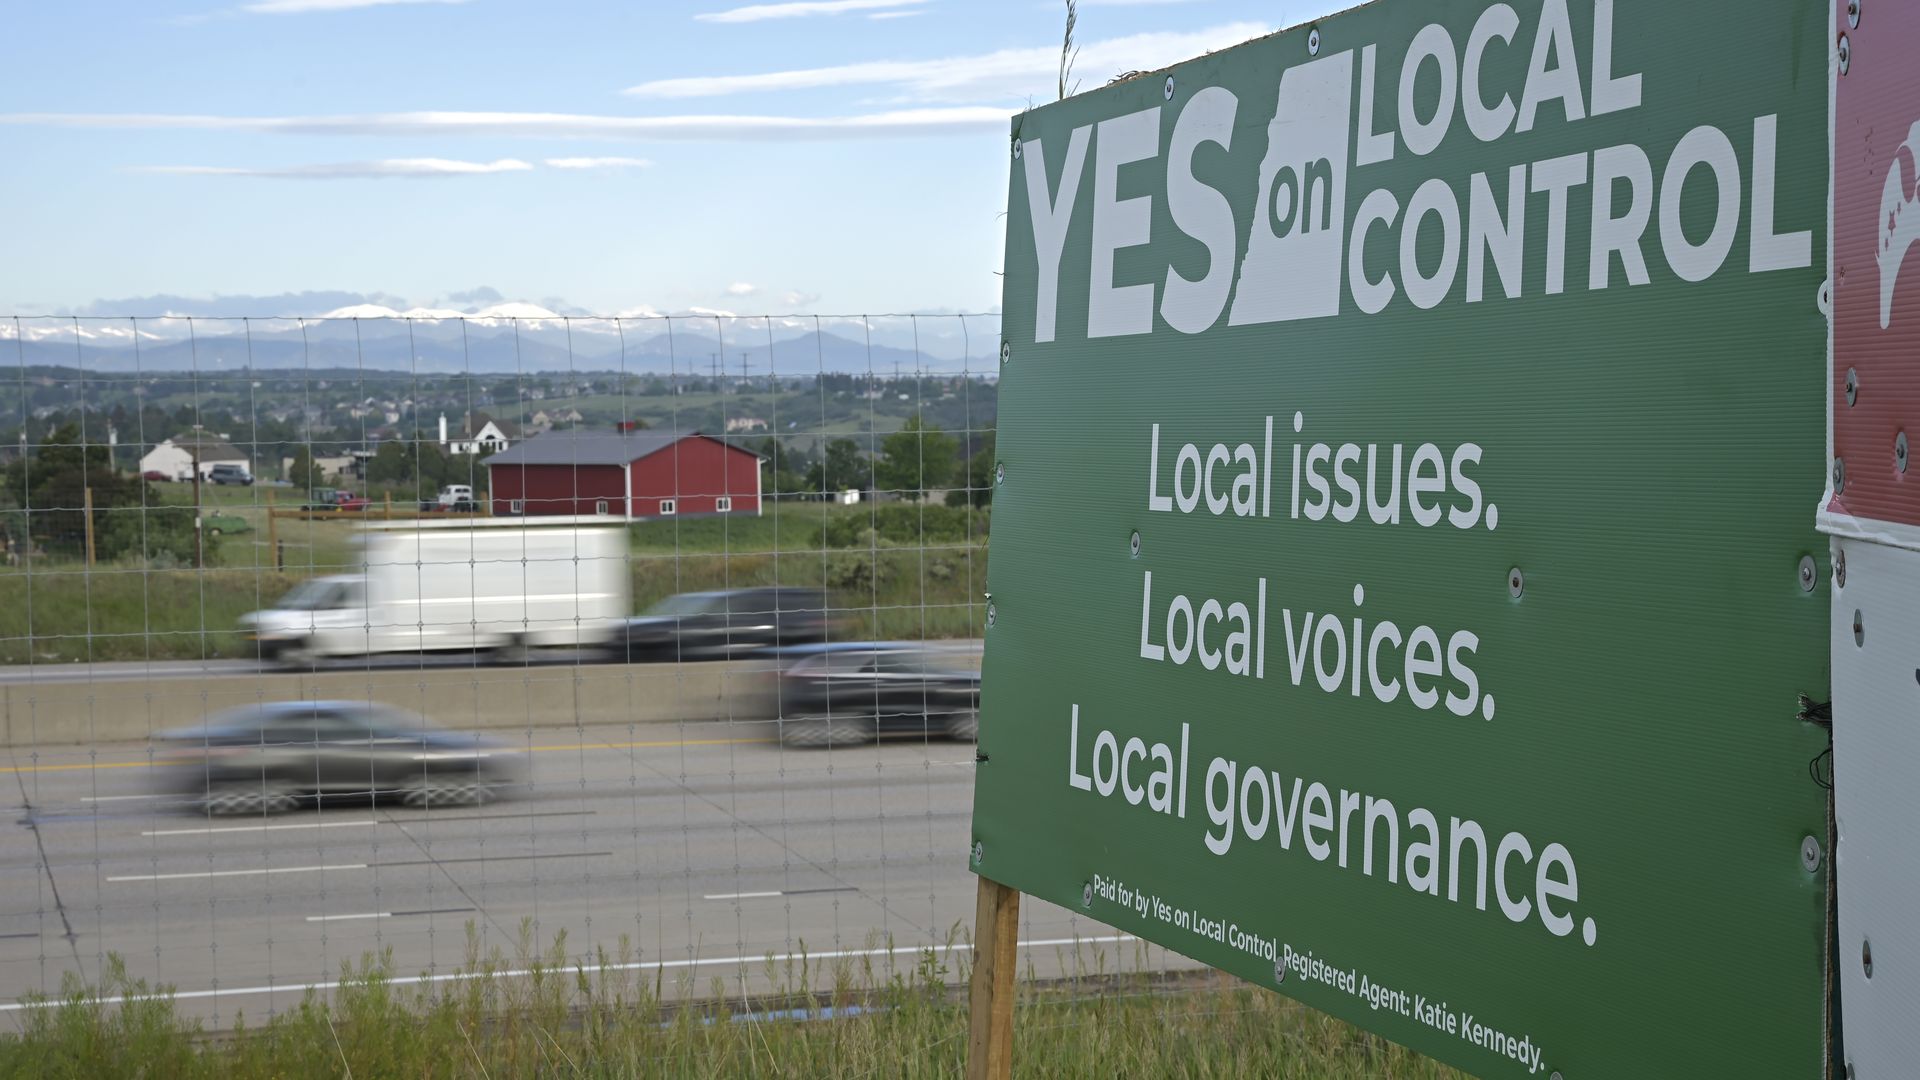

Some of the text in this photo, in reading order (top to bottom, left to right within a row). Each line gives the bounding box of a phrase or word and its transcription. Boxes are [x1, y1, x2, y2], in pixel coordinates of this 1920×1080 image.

[1356, 0, 1643, 167] LOCAL
[1022, 86, 1333, 344] YES on
[1348, 114, 1812, 315] CONTROL
[1148, 410, 1499, 531] Local issues.
[1140, 570, 1495, 722] Local voices.
[1069, 703, 1597, 947] Local governance.
[1094, 874, 1116, 902] Paid
[1118, 883, 1133, 908] for
[1136, 888, 1150, 919] by
[1152, 895, 1172, 923] Yes
[1174, 908, 1190, 930] on
[1193, 910, 1226, 943] Local
[1283, 943, 1356, 995] Registered
[1359, 974, 1410, 1017] Agent:
[1414, 994, 1457, 1035] Katie
[1461, 1012, 1545, 1074] Kennedy.
